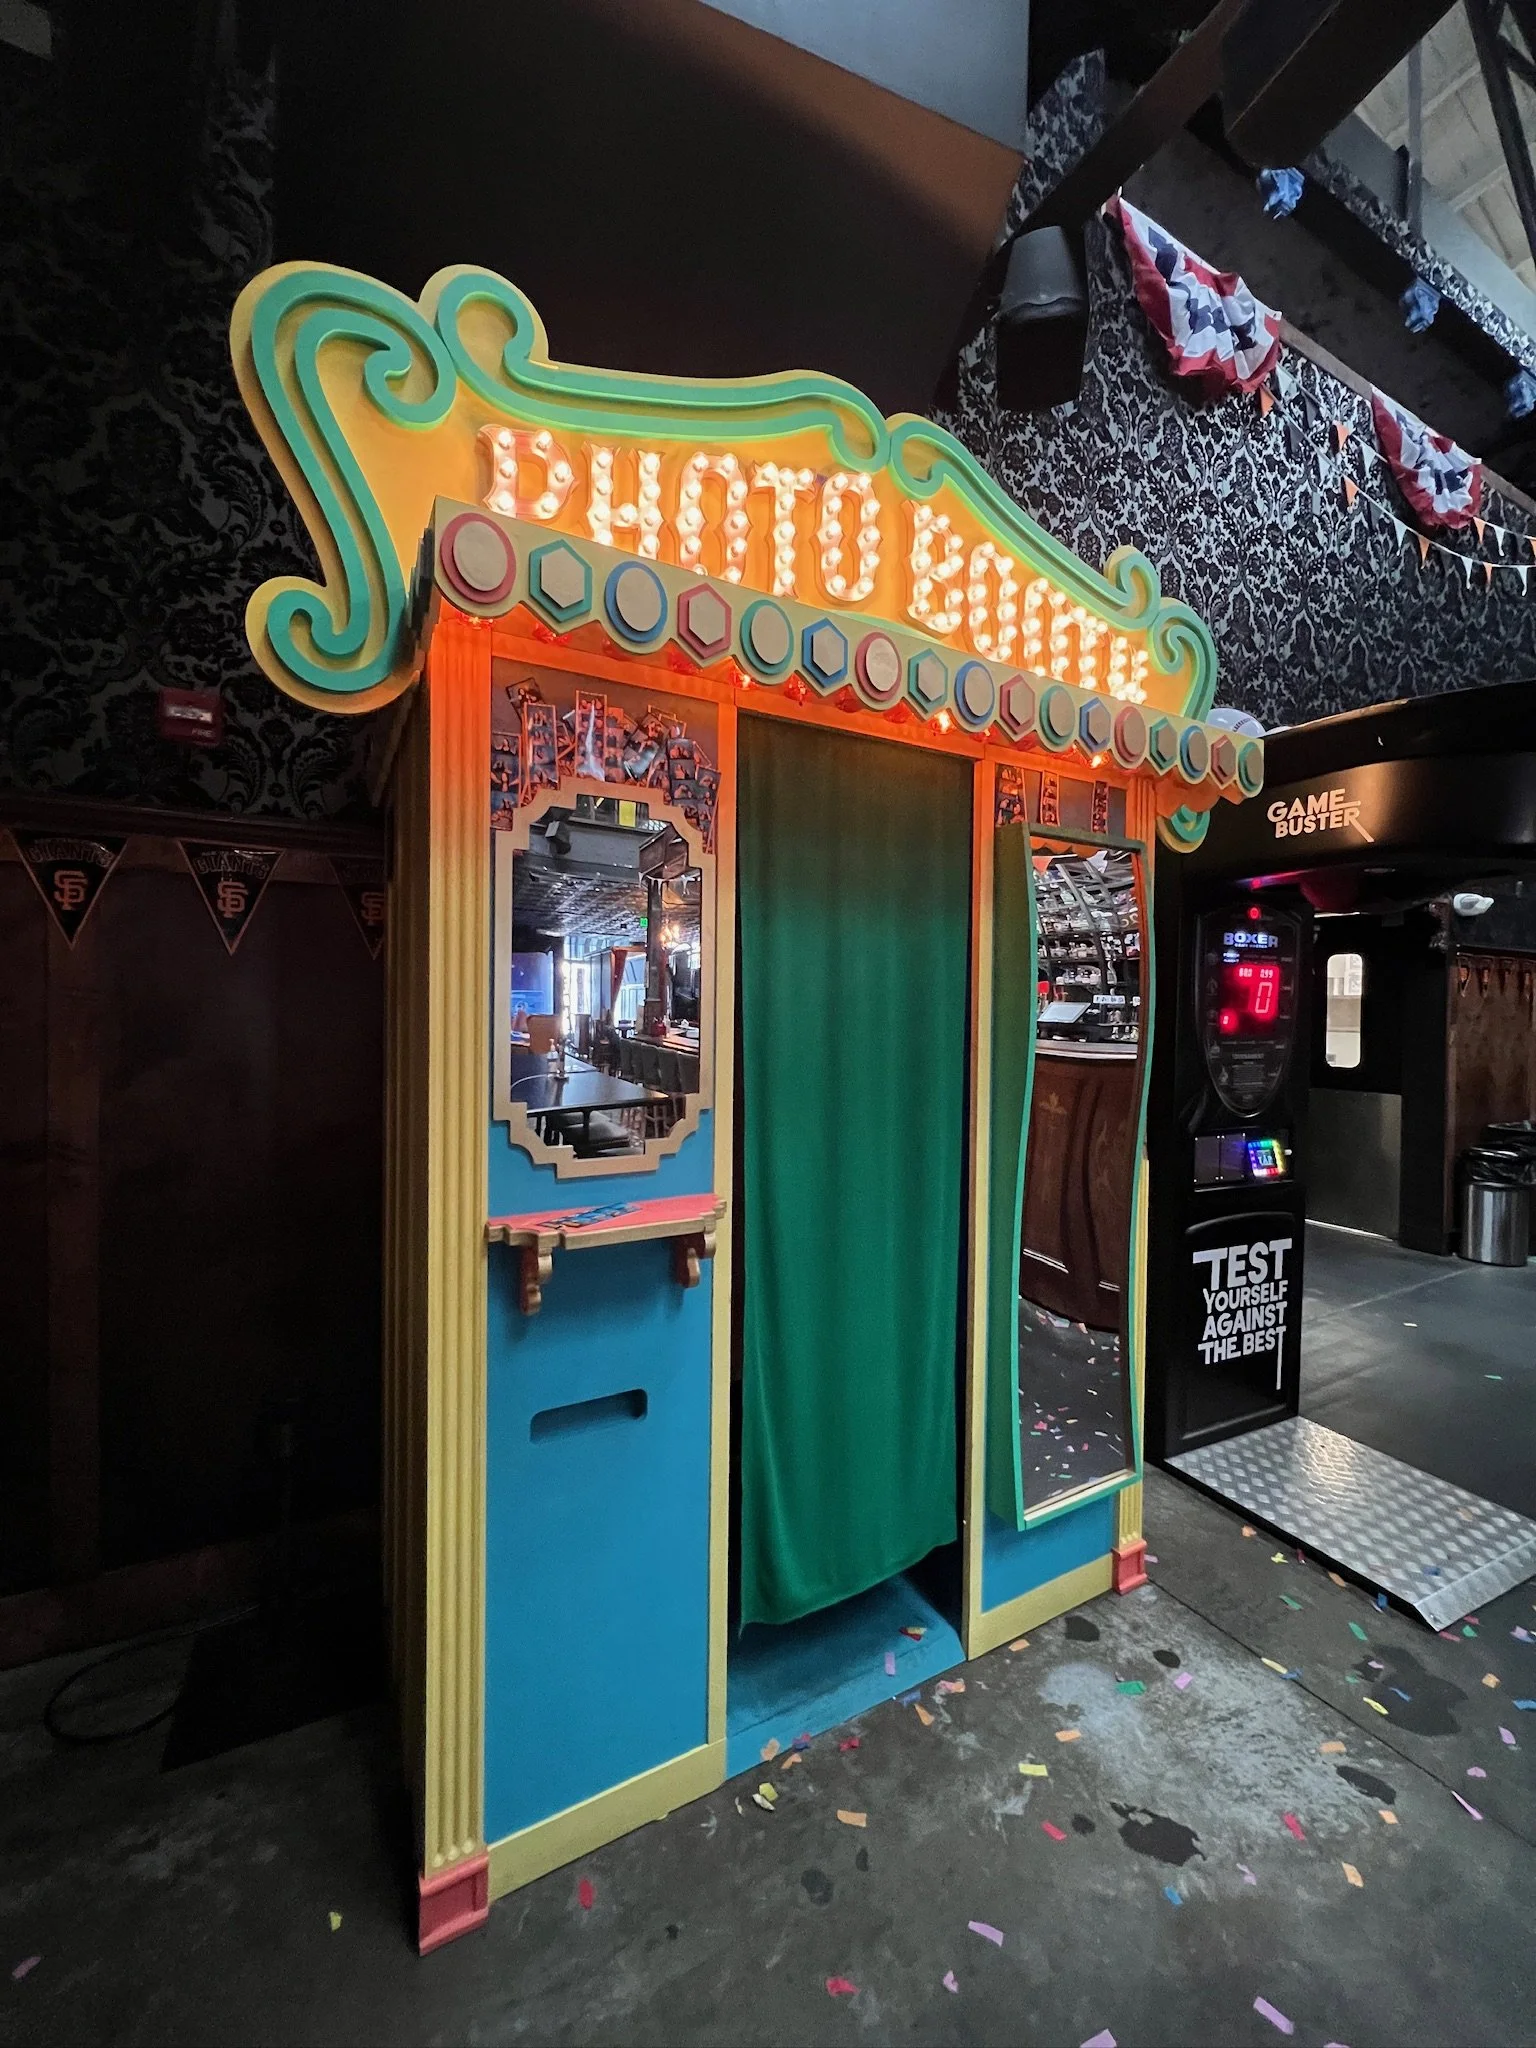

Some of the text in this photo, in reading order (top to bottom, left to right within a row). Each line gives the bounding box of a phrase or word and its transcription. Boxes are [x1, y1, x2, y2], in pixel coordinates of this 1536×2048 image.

[476, 423, 1151, 704] PHOTO BOOTH
[1266, 788, 1362, 824] GAME
[1274, 806, 1375, 843] BUSTER
[192, 852, 271, 881] GIANTS
[1222, 930, 1279, 949] BOXER
[1192, 1237, 1293, 1292] TEST
[1202, 1279, 1289, 1314] YOURSELF
[1202, 1301, 1288, 1341] AGAINST
[1197, 1325, 1287, 1390] THE BEST
